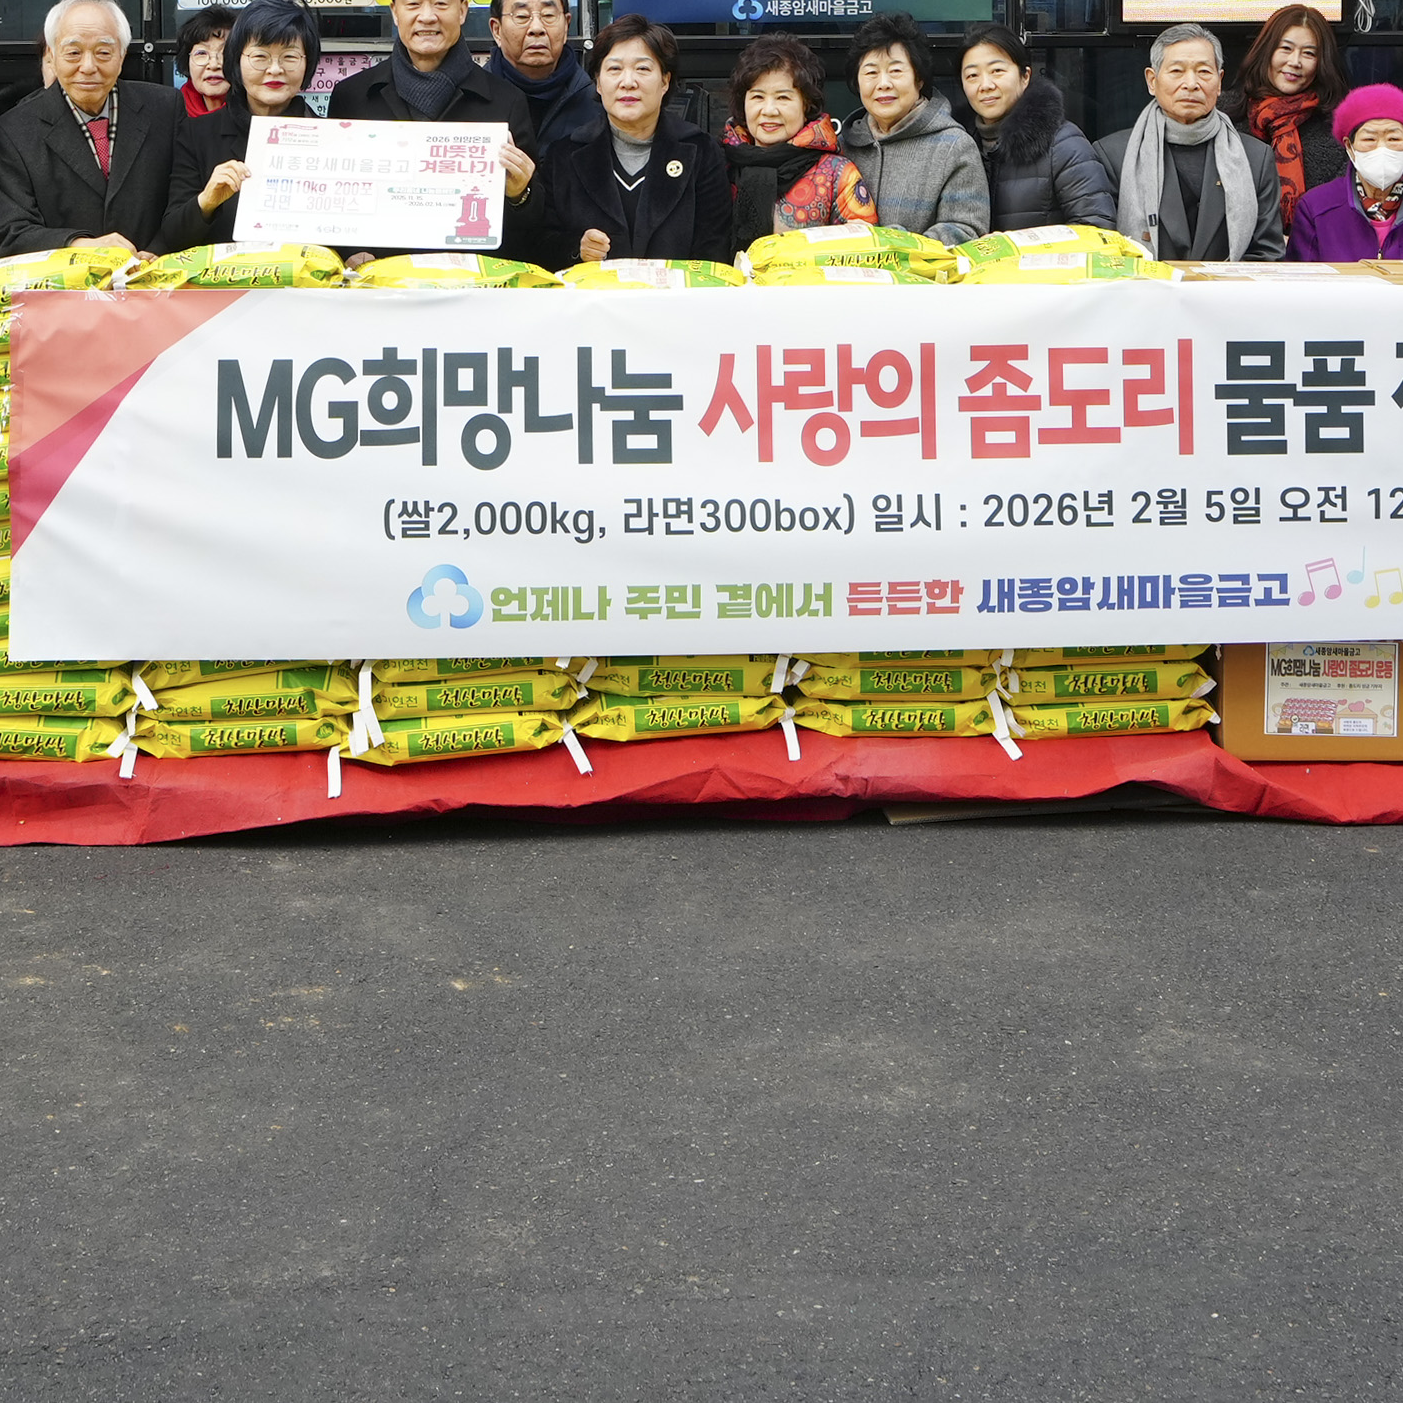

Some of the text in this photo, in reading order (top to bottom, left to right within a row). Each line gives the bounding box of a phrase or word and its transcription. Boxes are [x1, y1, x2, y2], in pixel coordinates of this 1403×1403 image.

[765, 0, 873, 16] 새종암새마을금고
[426, 135, 450, 144] 2026
[429, 145, 487, 159] 따뜻한
[268, 155, 410, 174] 새종암새마을금고
[418, 159, 495, 175] 겨울나기
[266, 178, 328, 194] 백미10kg
[264, 194, 291, 210] 라면
[215, 345, 684, 471] MG희망나눔
[697, 342, 937, 468] 사랑의
[958, 338, 1194, 458] 좀도리
[1213, 338, 1376, 455] 물품
[382, 498, 607, 545] (쌀2,000kg,
[623, 492, 857, 538] 라면300box)
[871, 490, 943, 535] 일시
[959, 502, 969, 529] :
[983, 489, 1116, 530] 2026년
[1130, 486, 1190, 527] 2월
[1205, 486, 1265, 526] 5일
[1279, 485, 1350, 525] 오전
[490, 572, 1292, 623] 언제나 주민 곁에서 든든한 새종암새마을금고
